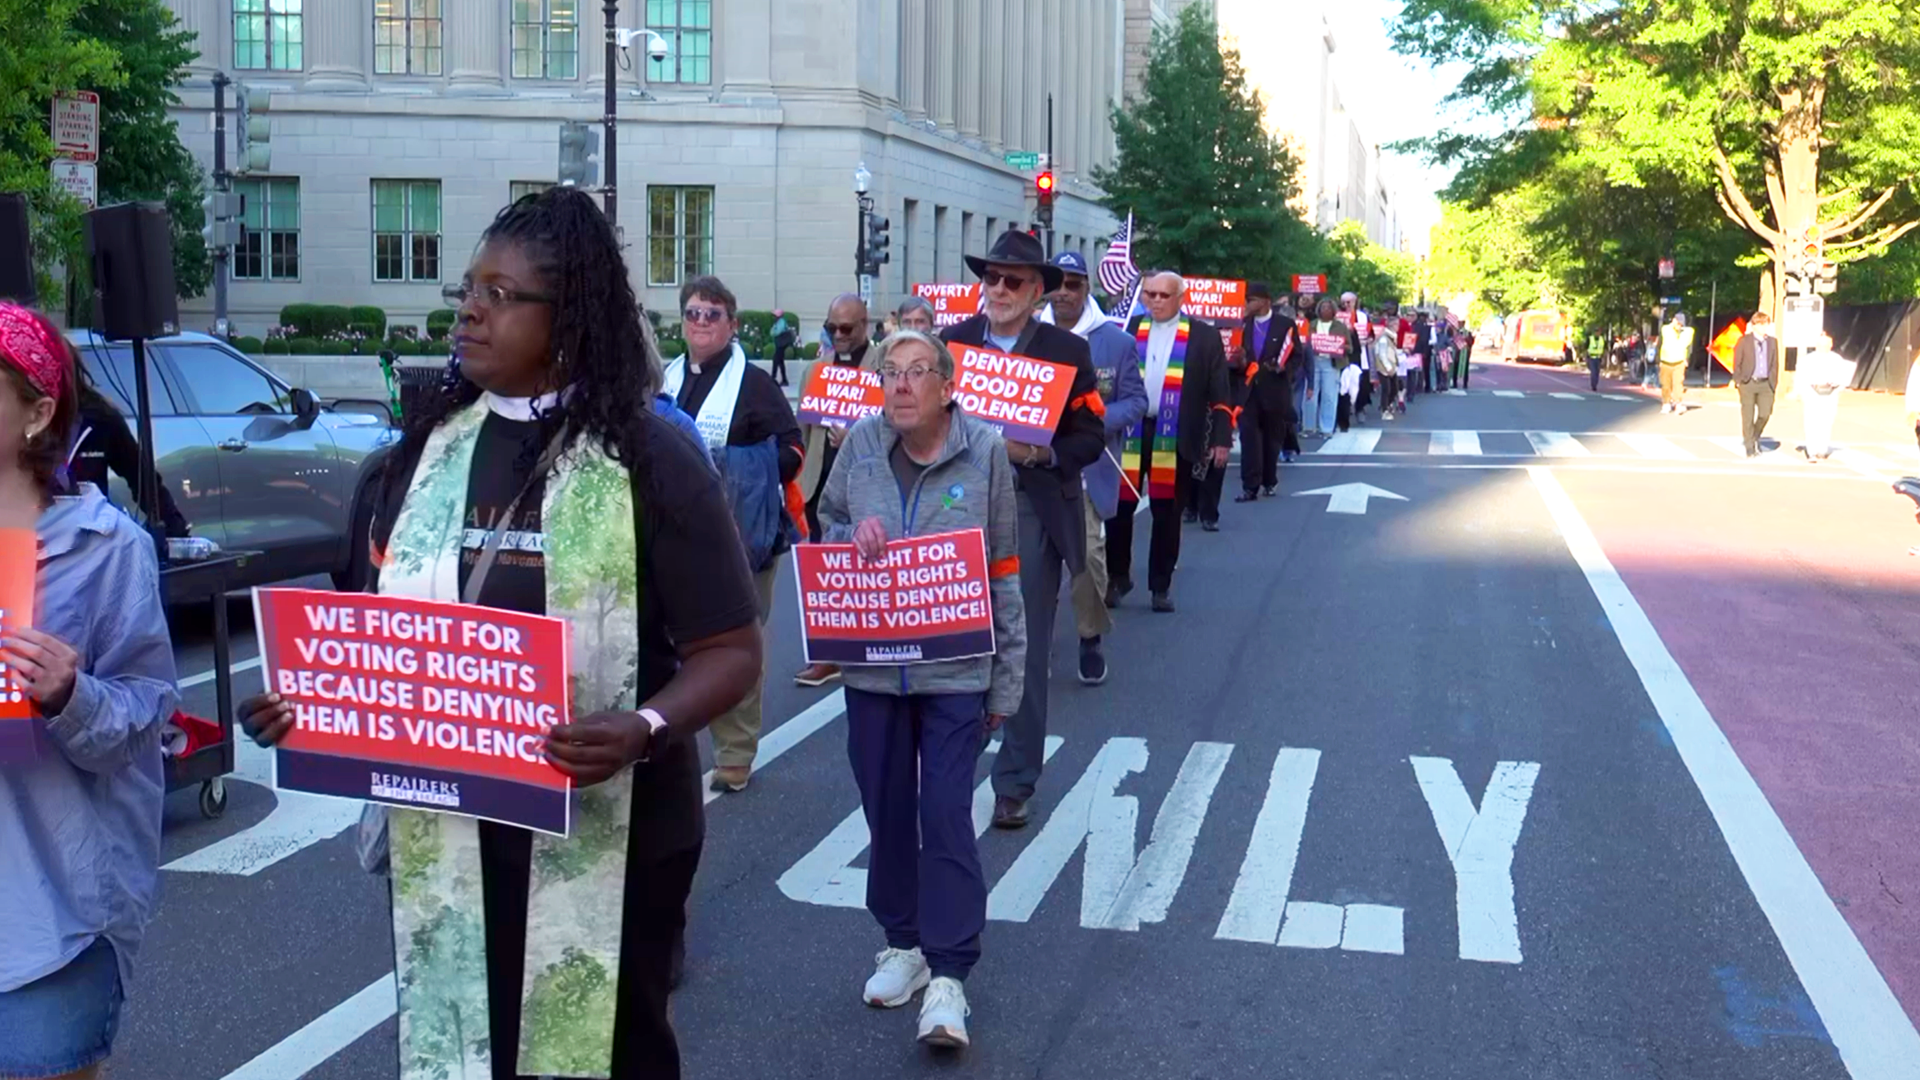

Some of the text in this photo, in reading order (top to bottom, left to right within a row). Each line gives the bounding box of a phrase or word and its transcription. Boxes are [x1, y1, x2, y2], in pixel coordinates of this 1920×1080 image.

[917, 284, 974, 298] POVERTY
[1183, 280, 1237, 293] STOP THE
[1189, 291, 1223, 305] WAR!
[934, 298, 948, 311] IS
[1180, 303, 1242, 319] AVE LIVES!
[820, 366, 857, 383] STOP
[962, 349, 1055, 383] DENYING
[826, 382, 865, 401] WAR!
[960, 371, 1044, 403] FOOD IS
[801, 395, 882, 418] SAVE LIVES!
[821, 552, 851, 569] WE
[918, 542, 957, 563] FOR
[816, 562, 968, 589] VOTING RIGHTS
[806, 581, 983, 609] BECAUSE DENYING
[806, 600, 986, 628] THEM IS VIOLENCE!
[303, 604, 523, 654] WE FIGHT FOR
[293, 637, 537, 692] VOTING RIGHTS
[278, 669, 559, 728] BECAUSE DENYING
[292, 703, 549, 766] HEM IS VIOLENC
[371, 771, 459, 795] REPAIRERS
